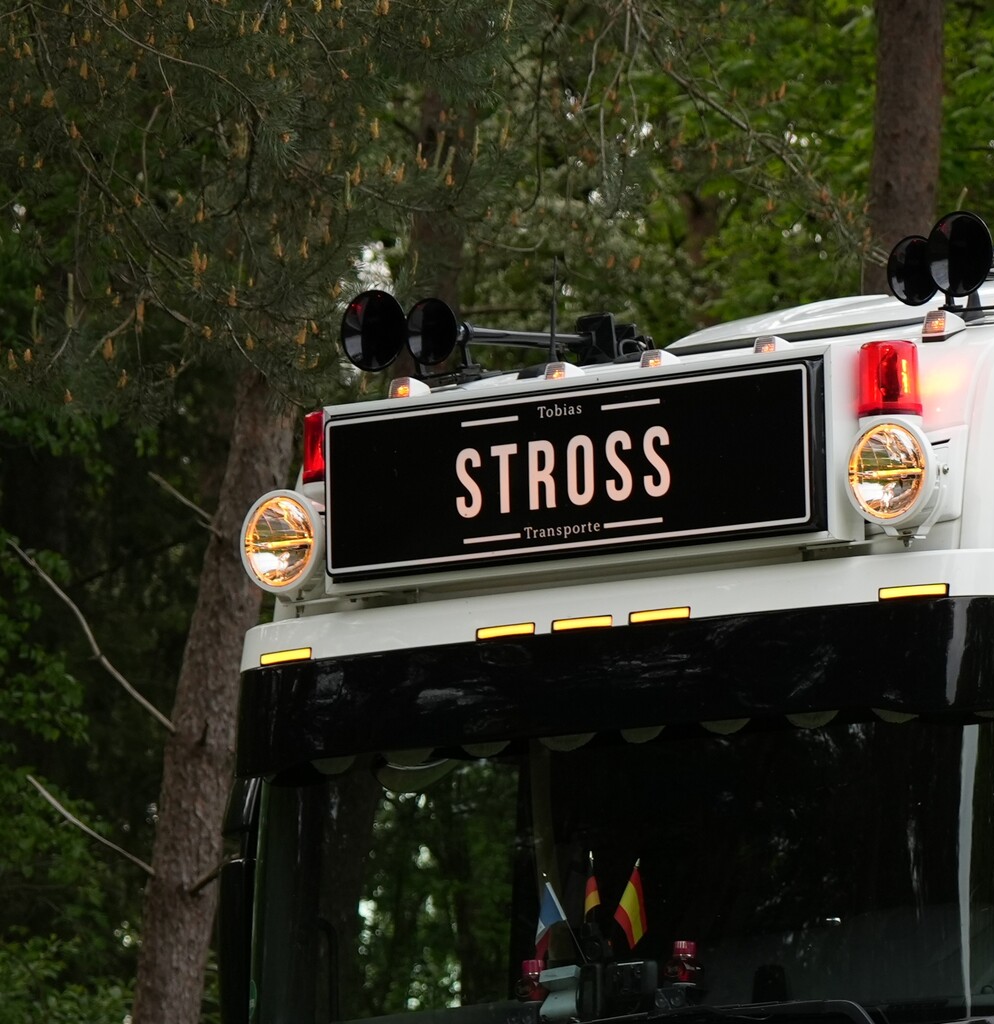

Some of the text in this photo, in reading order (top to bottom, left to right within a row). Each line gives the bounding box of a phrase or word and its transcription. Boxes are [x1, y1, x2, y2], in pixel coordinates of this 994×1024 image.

[537, 403, 582, 418] Tobias
[455, 425, 672, 519] STROSS
[523, 521, 601, 540] Transporte
